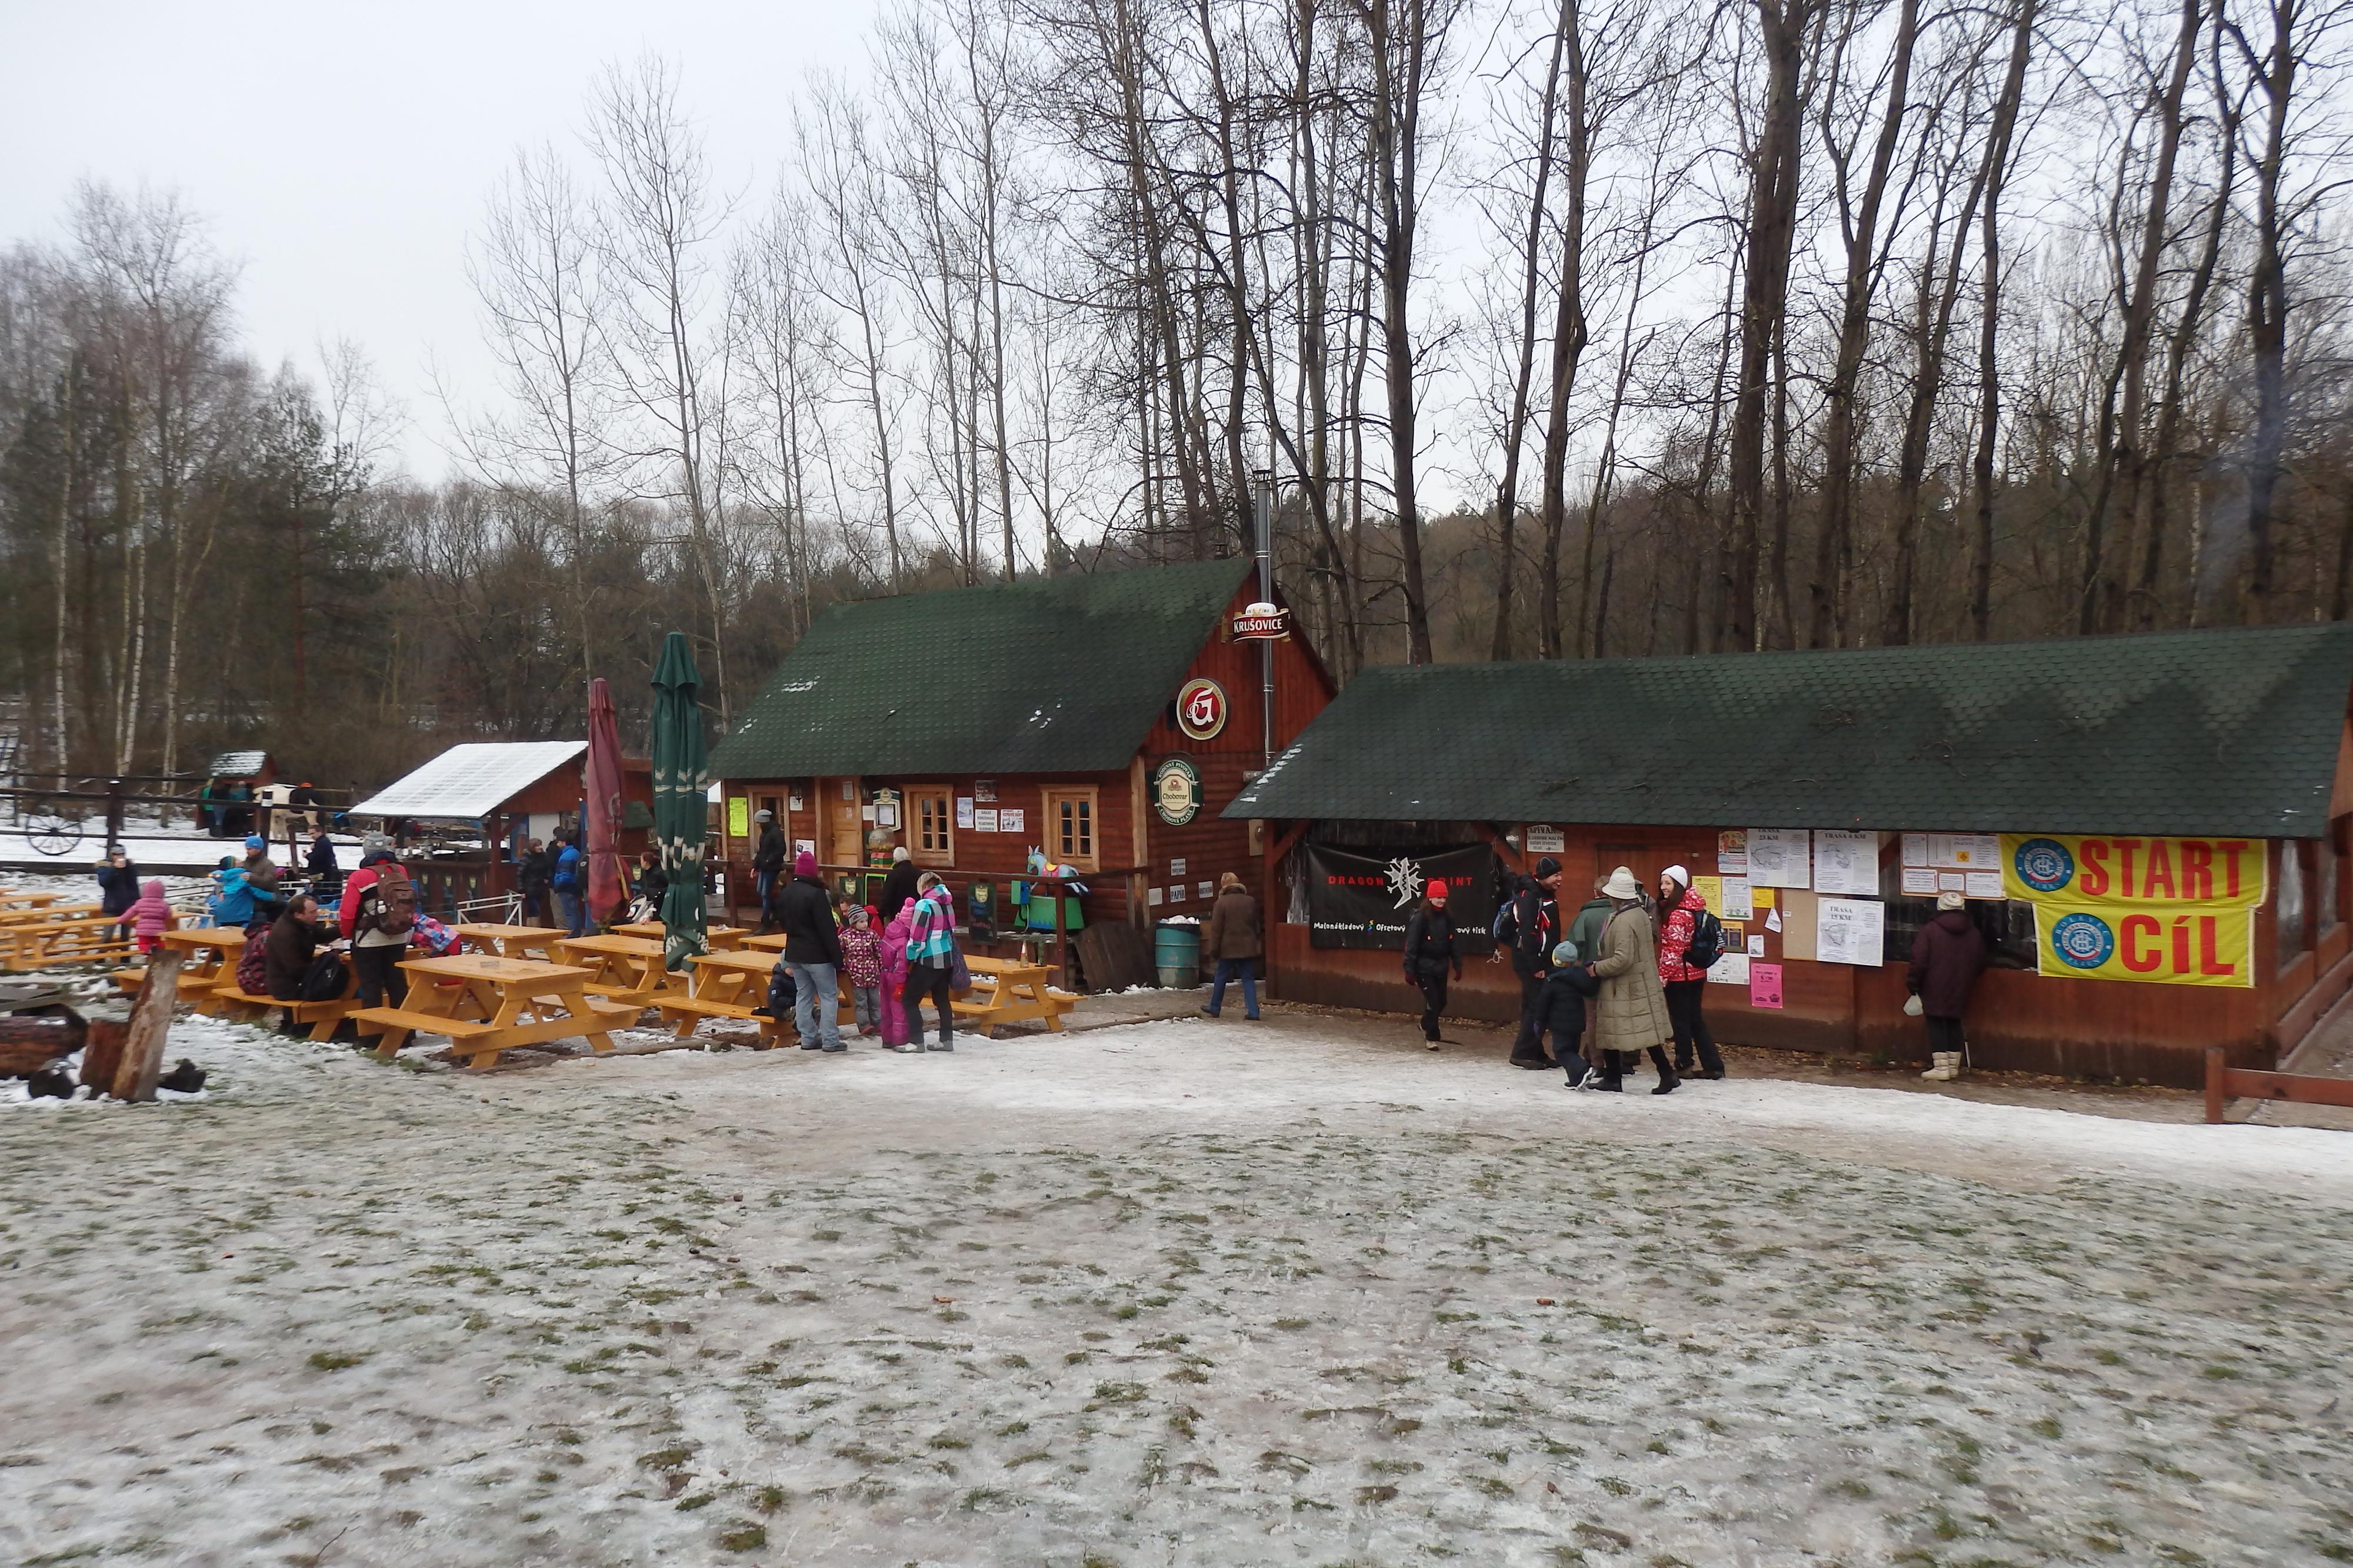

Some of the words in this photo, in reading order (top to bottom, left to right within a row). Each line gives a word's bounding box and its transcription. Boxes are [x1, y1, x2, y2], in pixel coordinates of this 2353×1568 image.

[1234, 618, 1282, 633] KRUŠOVICE
[2079, 839, 2248, 899] START
[1328, 876, 1384, 885] DRAGON
[1314, 922, 1364, 931] Malonákladový
[1376, 923, 1406, 932] Ofsetový
[1472, 926, 1487, 935] tisk
[2120, 914, 2234, 975] CÍL
